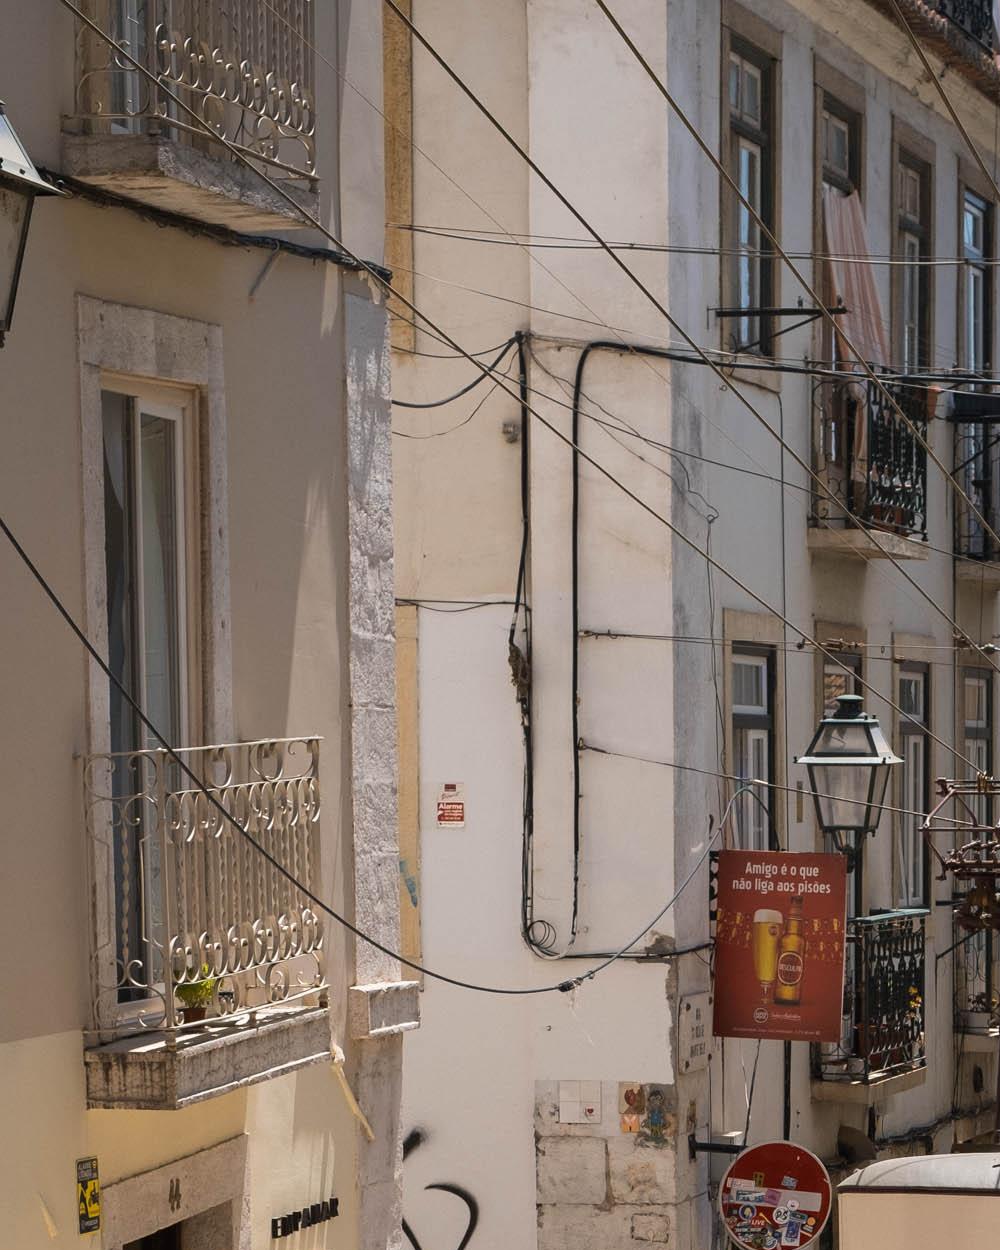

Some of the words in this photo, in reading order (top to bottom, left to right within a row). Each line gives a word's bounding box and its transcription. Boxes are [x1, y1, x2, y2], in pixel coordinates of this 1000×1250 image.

[745, 862, 778, 878] Amigo
[780, 863, 788, 876] é
[790, 866, 797, 876] o
[799, 866, 819, 880] que
[732, 878, 752, 890] não
[754, 878, 774, 895] liga
[777, 881, 795, 892] aos
[798, 880, 831, 896] pisões
[271, 1197, 340, 1239] EMPANAR
